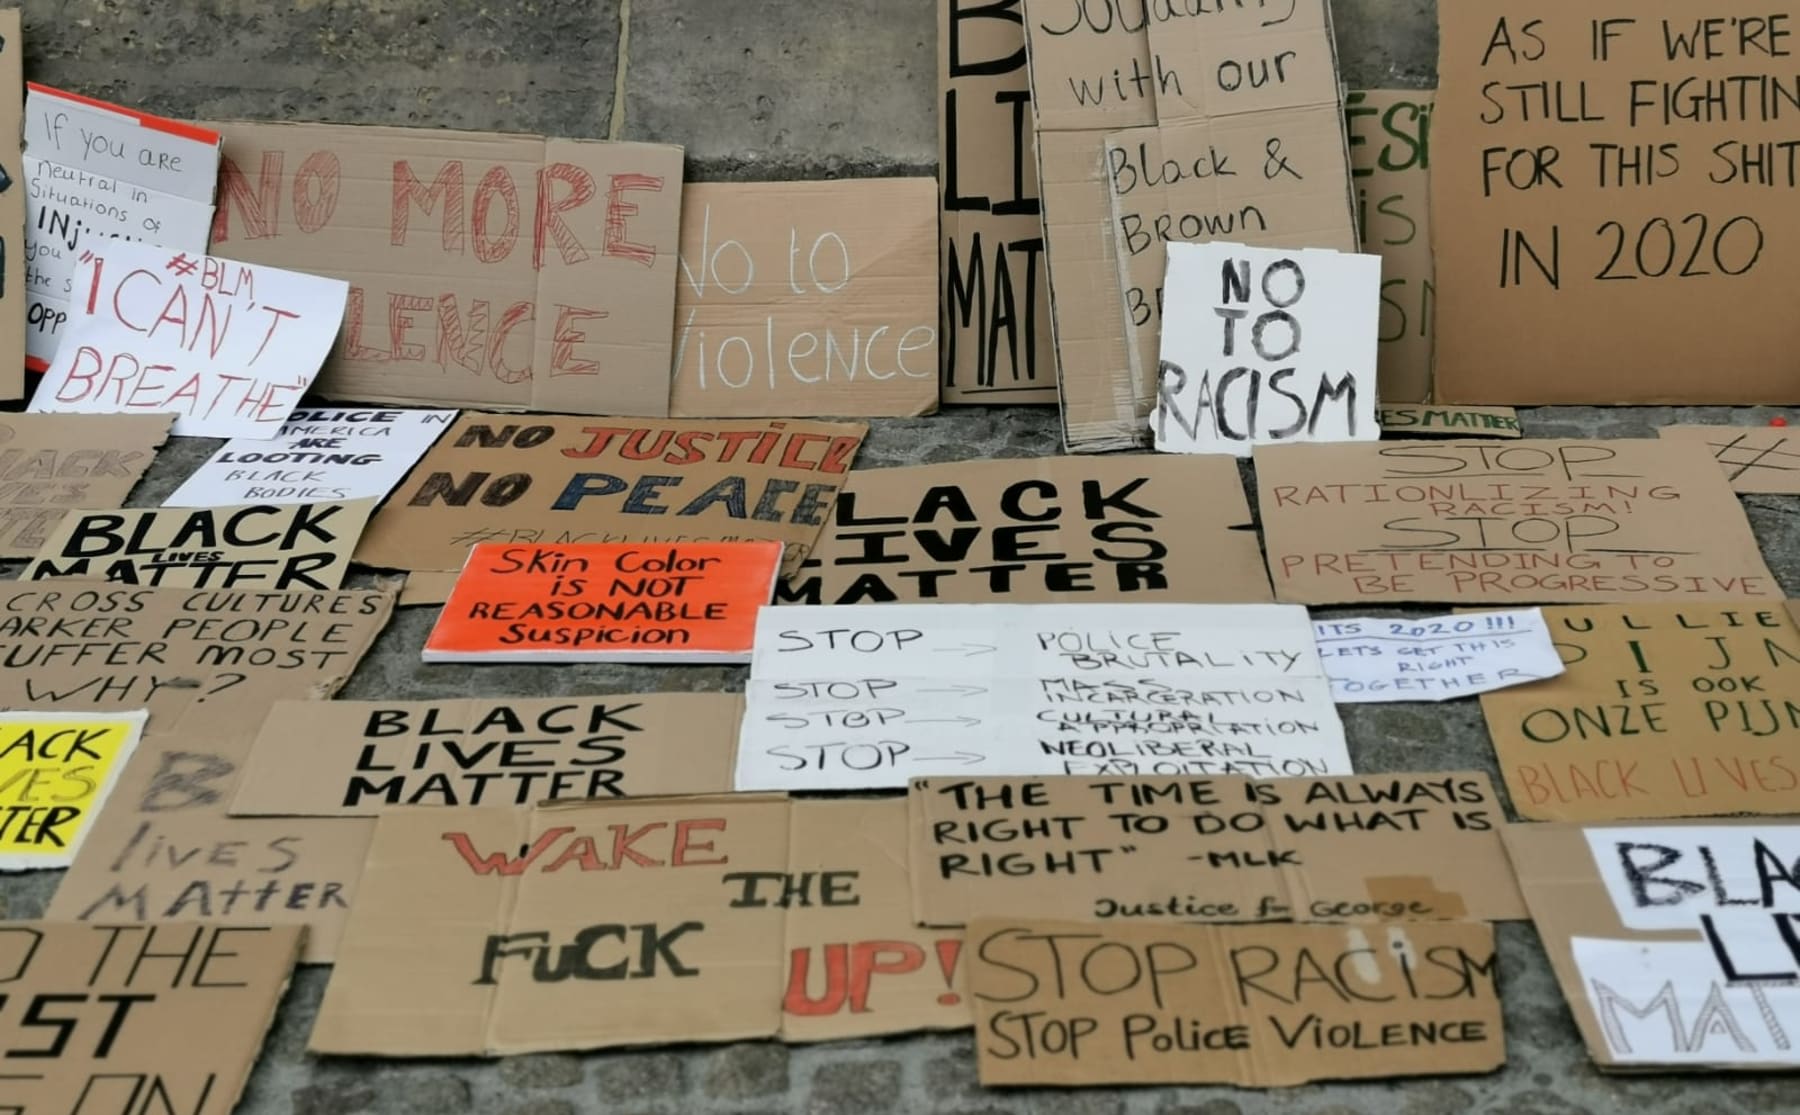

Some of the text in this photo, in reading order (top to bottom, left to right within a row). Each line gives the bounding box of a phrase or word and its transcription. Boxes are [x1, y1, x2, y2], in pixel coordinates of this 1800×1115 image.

[1480, 13, 1791, 66] AS IF WE'RE
[1068, 51, 1296, 106] with our
[1480, 75, 1800, 127] STILL FIGHTIN
[44, 111, 69, 150] If
[80, 128, 126, 161] you
[945, 89, 1042, 215] LI
[37, 160, 117, 194] neutral
[131, 188, 148, 204] in
[1108, 138, 1303, 195] Black &
[1482, 140, 1800, 197] FOR THIS SHIT
[212, 150, 666, 272] NO MORE
[24, 239, 62, 262] you
[789, 226, 850, 294] to
[1499, 213, 1764, 290] IN 2020
[1221, 257, 1306, 308] NO
[112, 267, 301, 367] CAN'T
[949, 231, 1044, 388] MAT
[344, 286, 610, 385] LENCE
[1213, 306, 1301, 361] TO
[286, 411, 404, 422] OLICE
[1157, 359, 1357, 443] RACISM
[288, 437, 348, 450] ARE
[453, 423, 556, 449] NO
[216, 451, 384, 466] LOOTING
[224, 470, 327, 482] BLACK
[1379, 445, 1617, 480] STOP
[244, 486, 351, 499] BODIES
[407, 472, 838, 526] NO PEACE
[835, 477, 1163, 527] LACK
[1273, 483, 1681, 507] RATIONLIZING
[1430, 501, 1634, 517] RACISM!
[61, 503, 344, 558] BLACK
[801, 522, 1168, 567] IVES
[1383, 514, 1619, 553] STOP
[31, 552, 338, 591] MATTER
[151, 551, 226, 563] LIVES
[614, 548, 723, 574] Color
[1281, 552, 1602, 578] PRETENDING
[608, 575, 705, 598] NOT
[770, 562, 1170, 606] MATTER
[1353, 570, 1767, 596] BE PROGRESSIVE
[6, 590, 383, 615] CROSS CULTURES
[468, 601, 728, 622] REASONABLE
[0, 616, 354, 644] ARKER PEOPLE
[777, 629, 1181, 653] STOP POLICE
[1318, 624, 1363, 635] ITS
[1564, 611, 1781, 633] ULLIE
[0, 641, 168, 669] UFFER
[1060, 649, 1303, 672] BRUTALITY
[1396, 645, 1444, 655] GET
[1454, 639, 1517, 652] THIS
[1398, 656, 1475, 672] RIGHT
[773, 677, 1173, 699] STOP MASS
[1045, 689, 1306, 706] INCARCERATION
[1615, 675, 1766, 698] IS OOK
[363, 703, 645, 738] BLACK
[766, 708, 1237, 728] STOP CULTURAL
[1521, 702, 1668, 744] ONZE
[0, 728, 113, 763] ACK
[355, 735, 627, 772] LIVES
[766, 739, 1273, 770] STOP NEOLIBERAL
[341, 769, 628, 807] MATTER
[1089, 781, 1221, 808] TIME
[1245, 782, 1282, 805] IS
[1304, 780, 1485, 805] ALWAYS
[1517, 755, 1798, 805] BLACK LIVES
[0, 805, 81, 848] TER
[933, 808, 1493, 845] RIGHT TO DO WHAT IS
[441, 817, 728, 876] WAKE
[722, 870, 861, 908] THE
[1615, 836, 1800, 908] BLA
[1094, 896, 1240, 919] Justice
[87, 925, 273, 989] THE
[974, 927, 1198, 1010] STOP
[783, 939, 963, 1017] UP!
[0, 993, 156, 1059] ST
[1589, 976, 1797, 1053] MAT
[987, 1010, 1099, 1061] STOP
